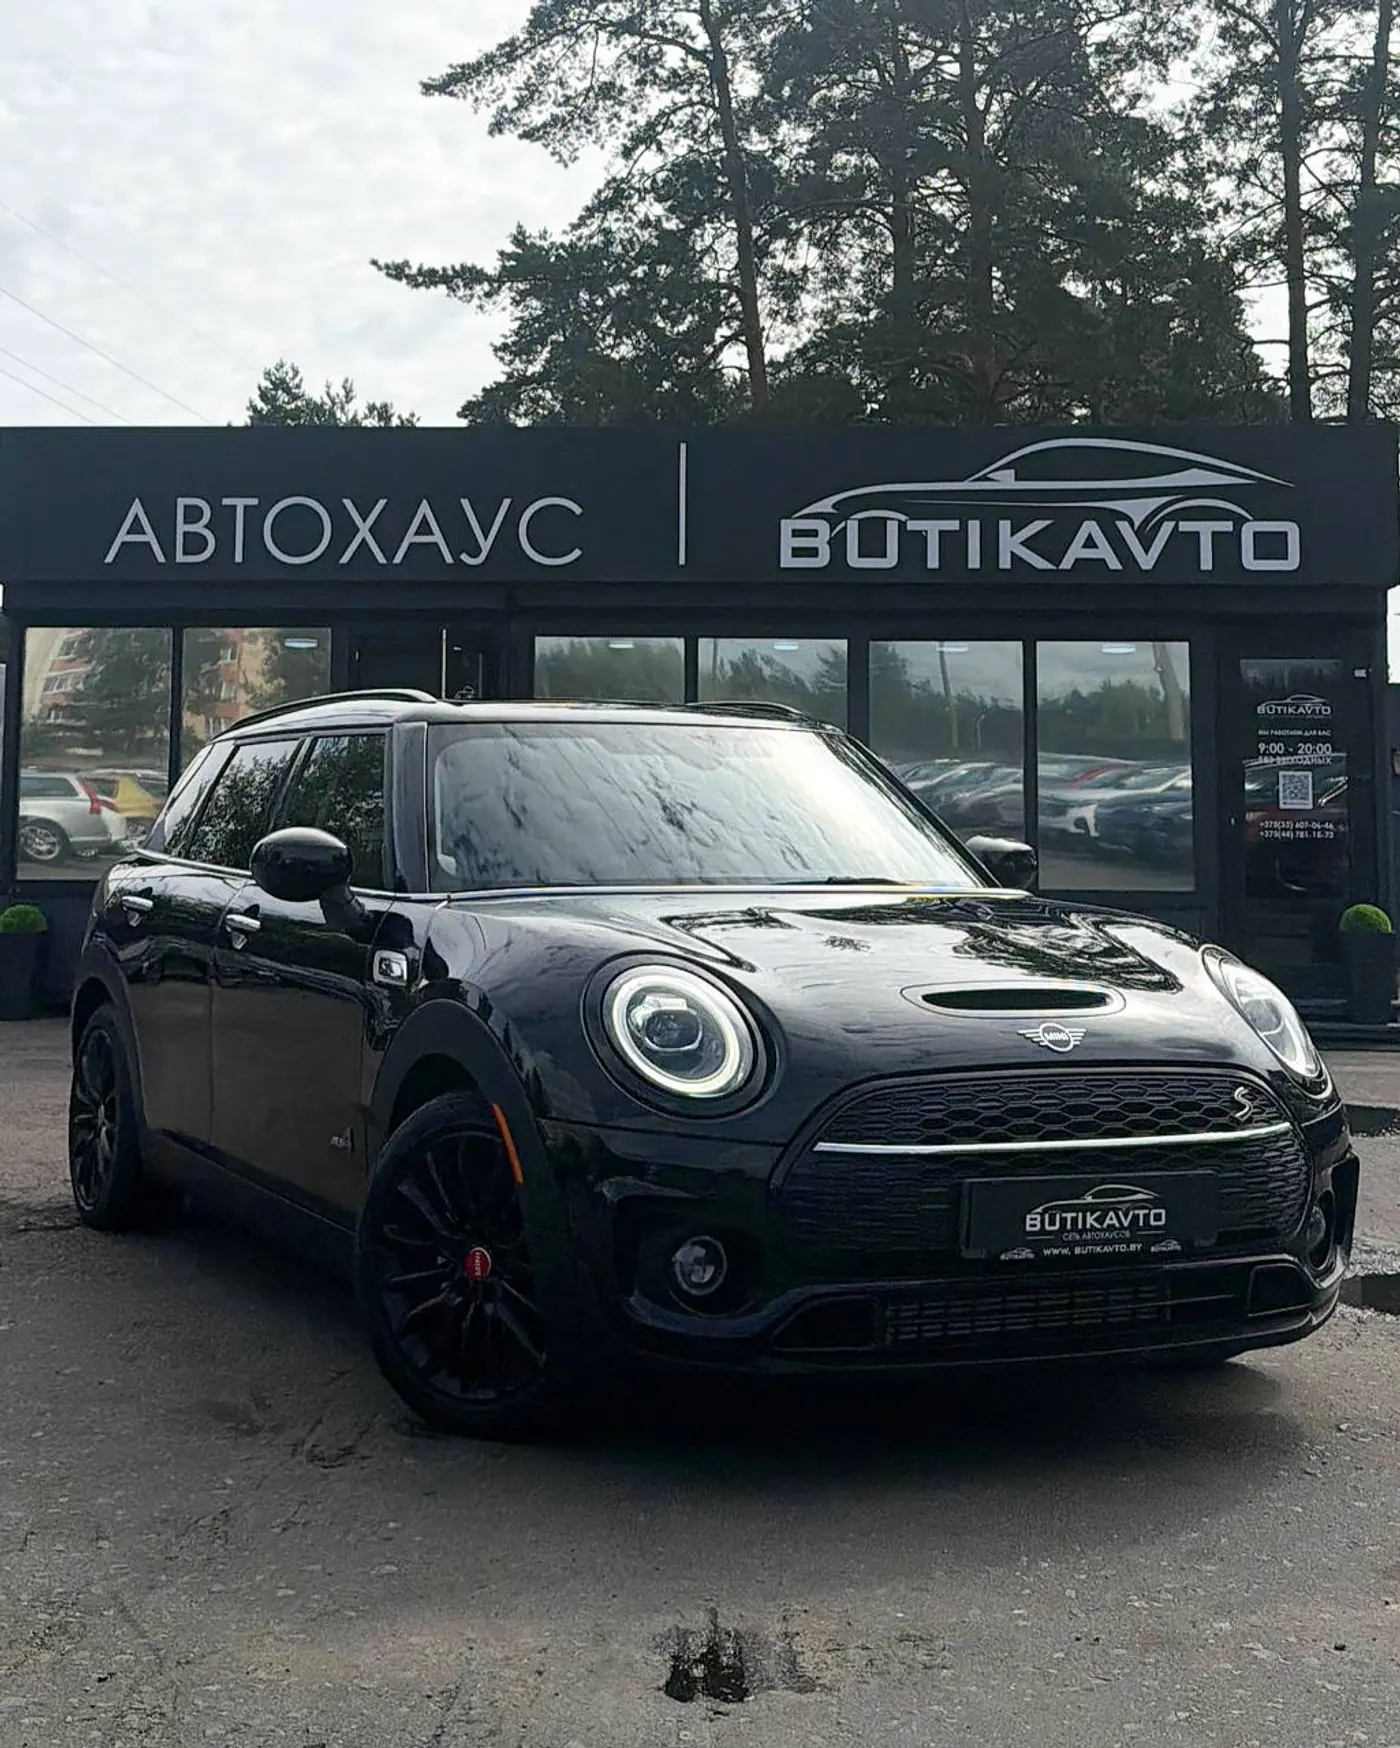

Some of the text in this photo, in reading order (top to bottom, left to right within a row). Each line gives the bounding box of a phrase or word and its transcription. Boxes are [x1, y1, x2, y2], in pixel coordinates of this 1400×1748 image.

[104, 496, 585, 566] АВТОХАУС
[779, 518, 1301, 571] BUTIKAVTO
[1256, 705, 1332, 715] BUTIKAVTO
[1258, 742, 1285, 754] 9:00
[1297, 742, 1332, 754] 20:00
[1234, 1086, 1251, 1119] S
[1025, 1208, 1166, 1232] BUTIKAVTO
